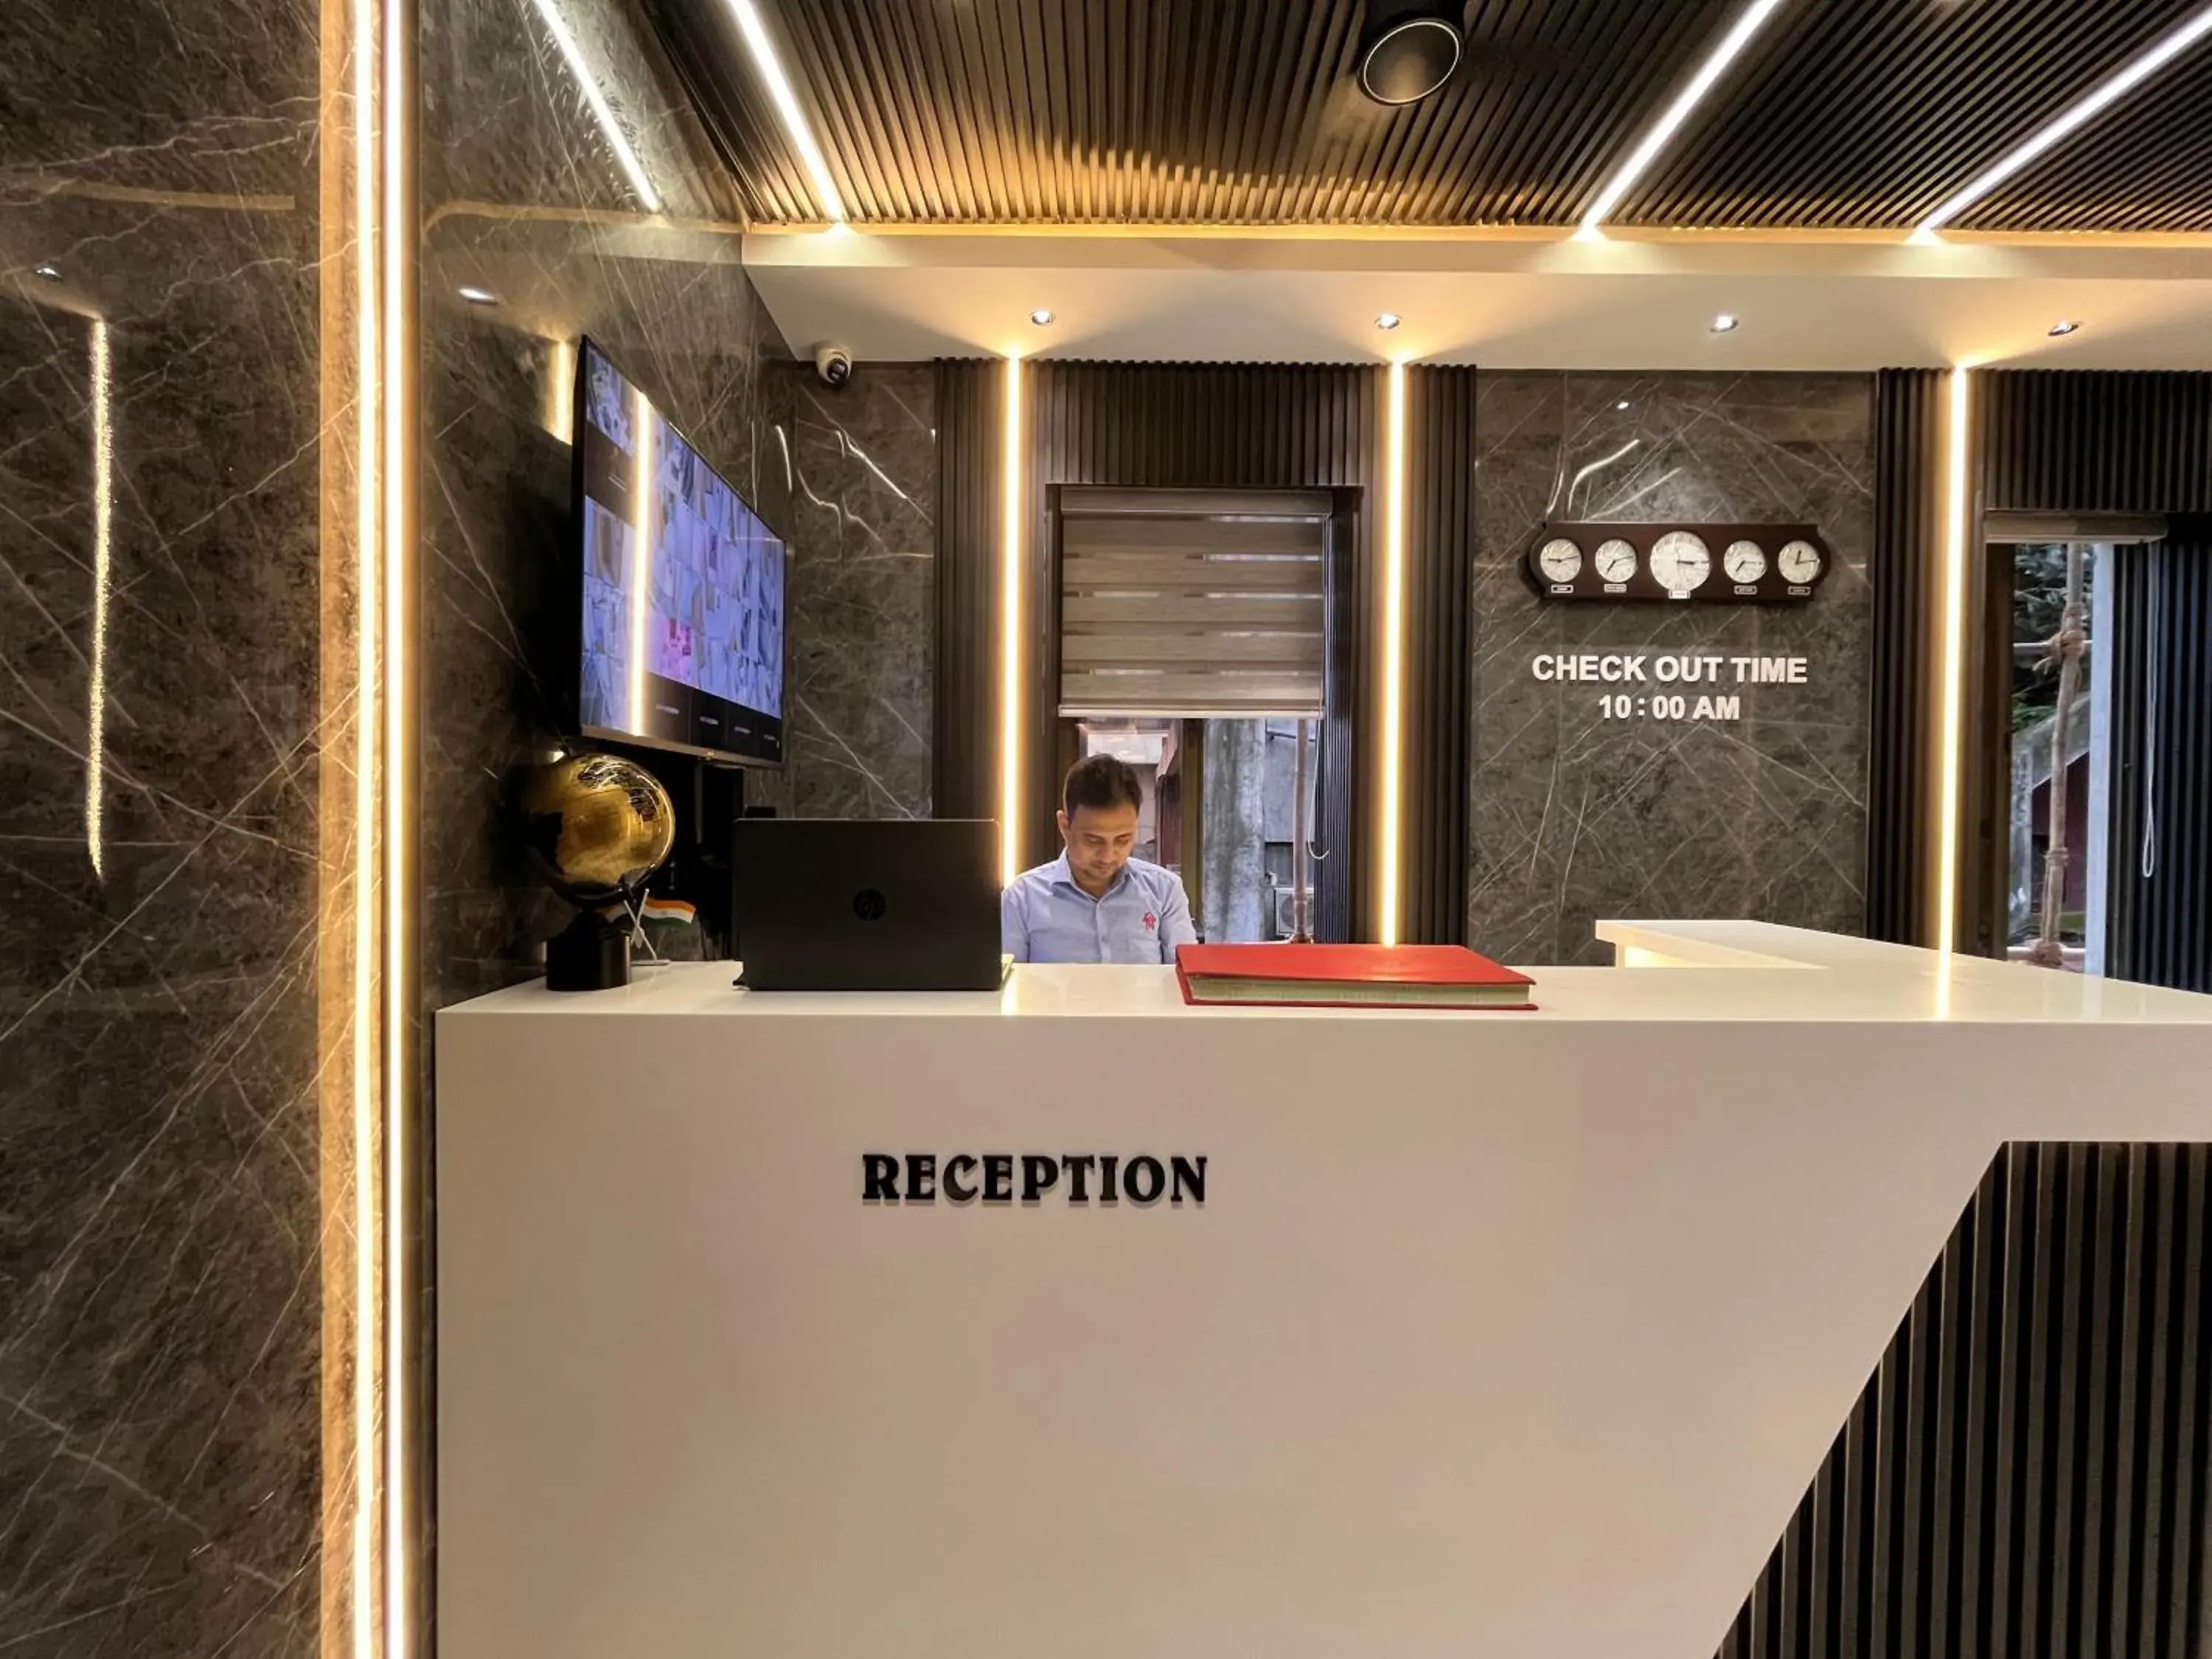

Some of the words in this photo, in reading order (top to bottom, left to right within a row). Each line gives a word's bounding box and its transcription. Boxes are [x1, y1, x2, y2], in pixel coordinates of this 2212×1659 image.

[1531, 655, 1646, 681] CHECK
[1655, 655, 1723, 682] OUT
[1731, 657, 1808, 684] TIME
[1692, 696, 1740, 720] AM
[862, 1154, 1208, 1203] RECEPTION
